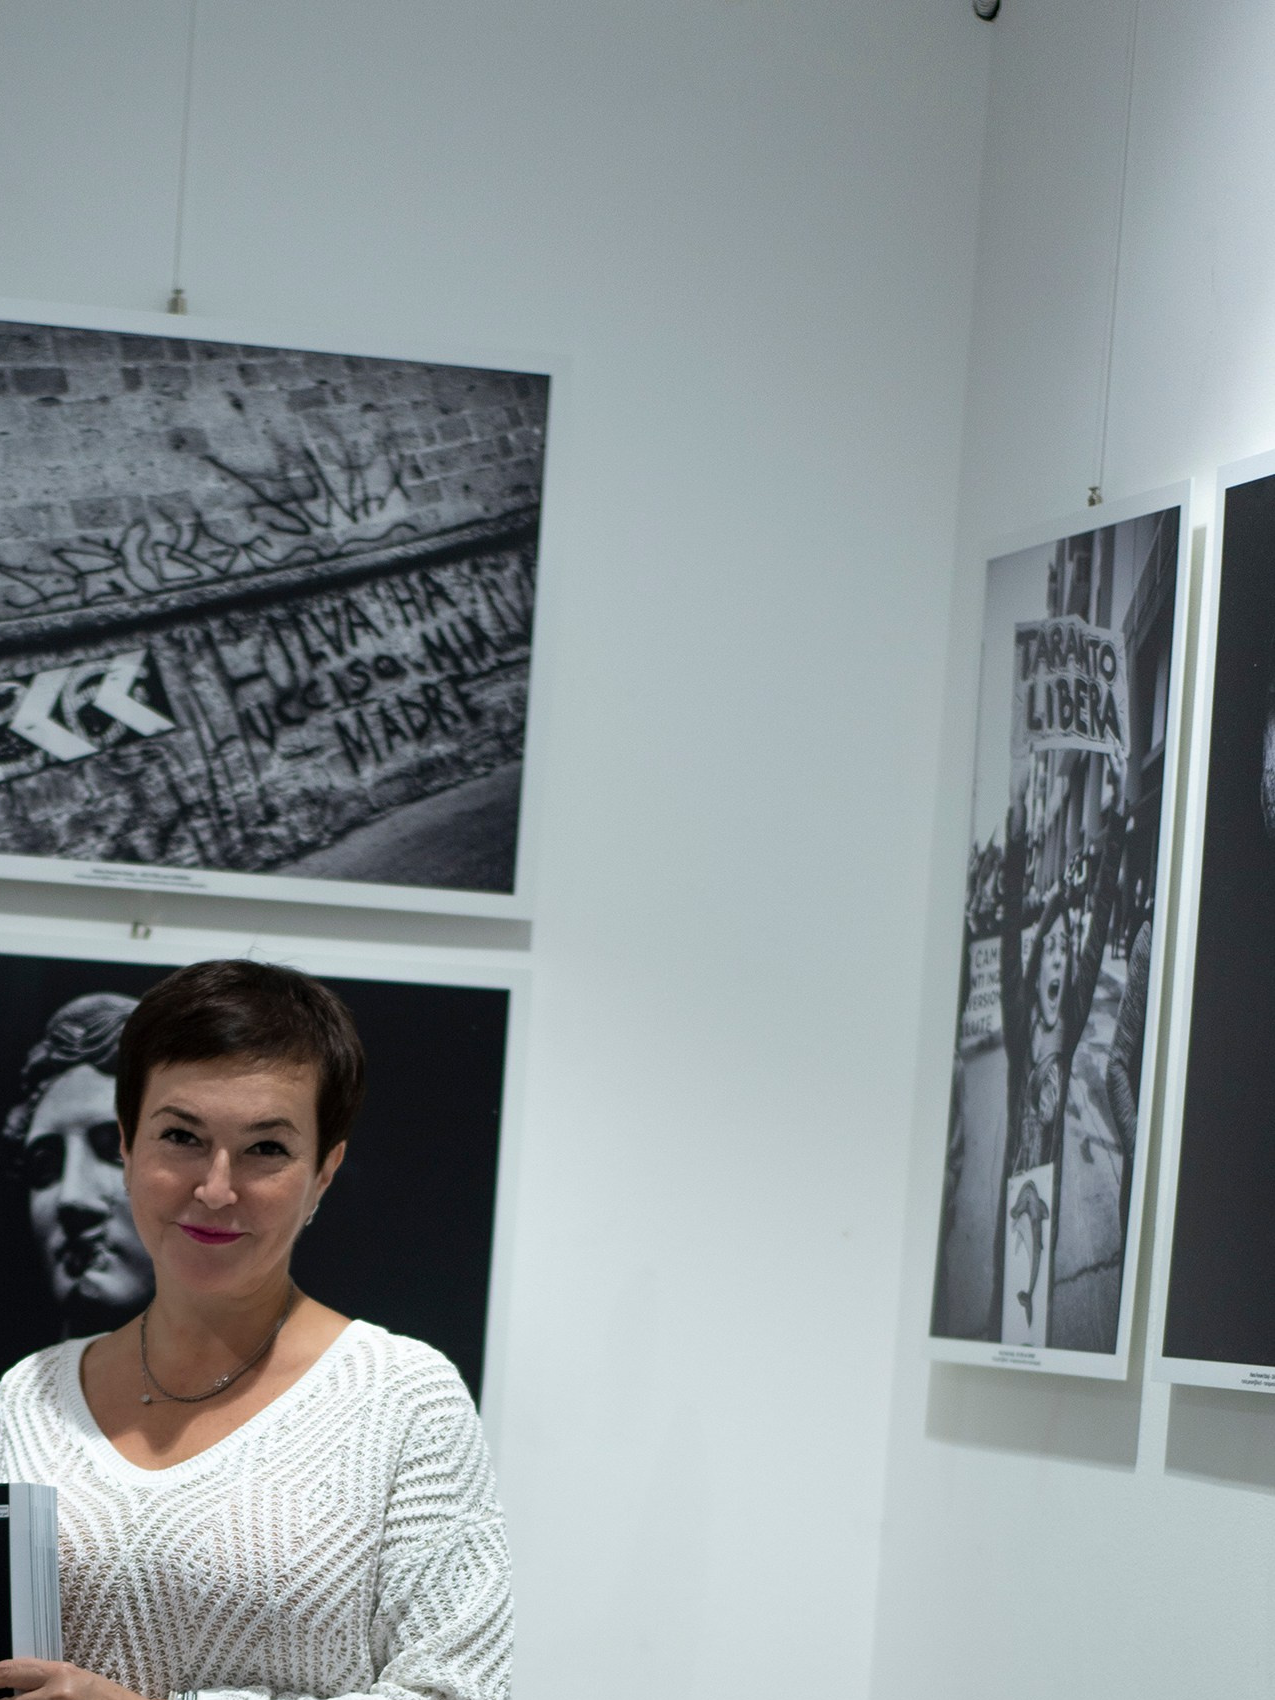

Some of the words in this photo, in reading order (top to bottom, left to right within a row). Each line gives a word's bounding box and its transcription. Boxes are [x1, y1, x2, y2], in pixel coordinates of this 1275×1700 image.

[1015, 626, 1118, 683] TARANTO
[333, 680, 483, 777] MADRE
[1026, 677, 1123, 743] LIBERA
